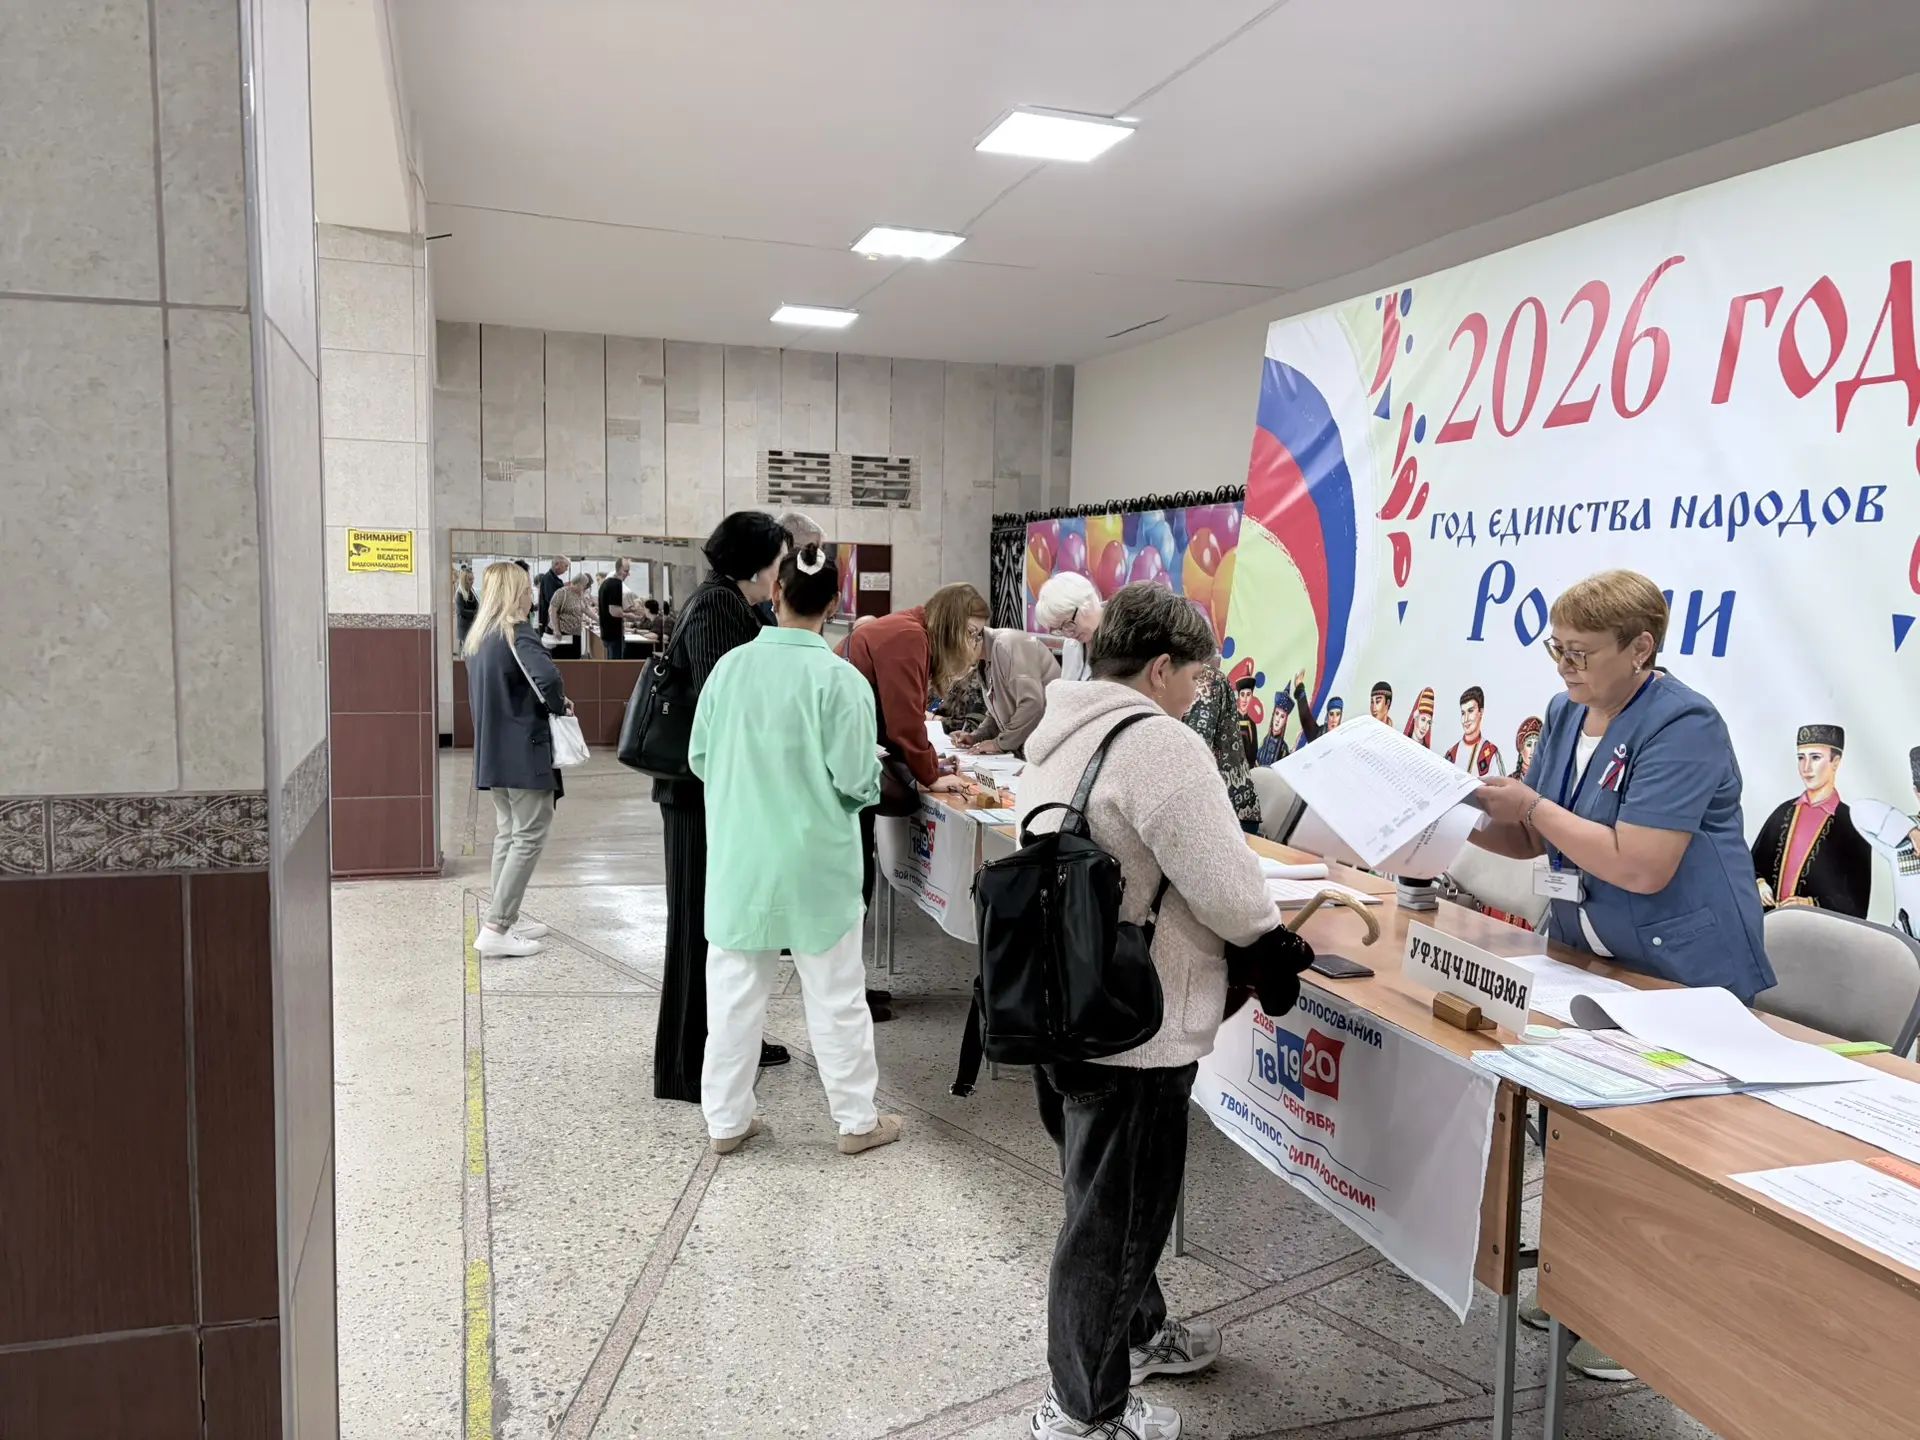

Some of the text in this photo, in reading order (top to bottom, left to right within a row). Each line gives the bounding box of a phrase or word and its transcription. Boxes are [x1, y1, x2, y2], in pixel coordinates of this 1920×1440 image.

[1434, 255, 1686, 446] 2026
[353, 533, 407, 542] ВНИМАНИЕ!
[1252, 1008, 1276, 1034] 2026
[1294, 995, 1383, 1050] ОЛОСОВАНИЯ
[1255, 1042, 1337, 1085] 18 19 20
[1283, 1093, 1336, 1138] СЕНТЯБРЯ
[1220, 1091, 1249, 1121] ТВОЙ
[1250, 1110, 1283, 1147] ГОЛОС
[1288, 1144, 1320, 1175] СИЛА
[1319, 1162, 1377, 1212] РОССИИ!
